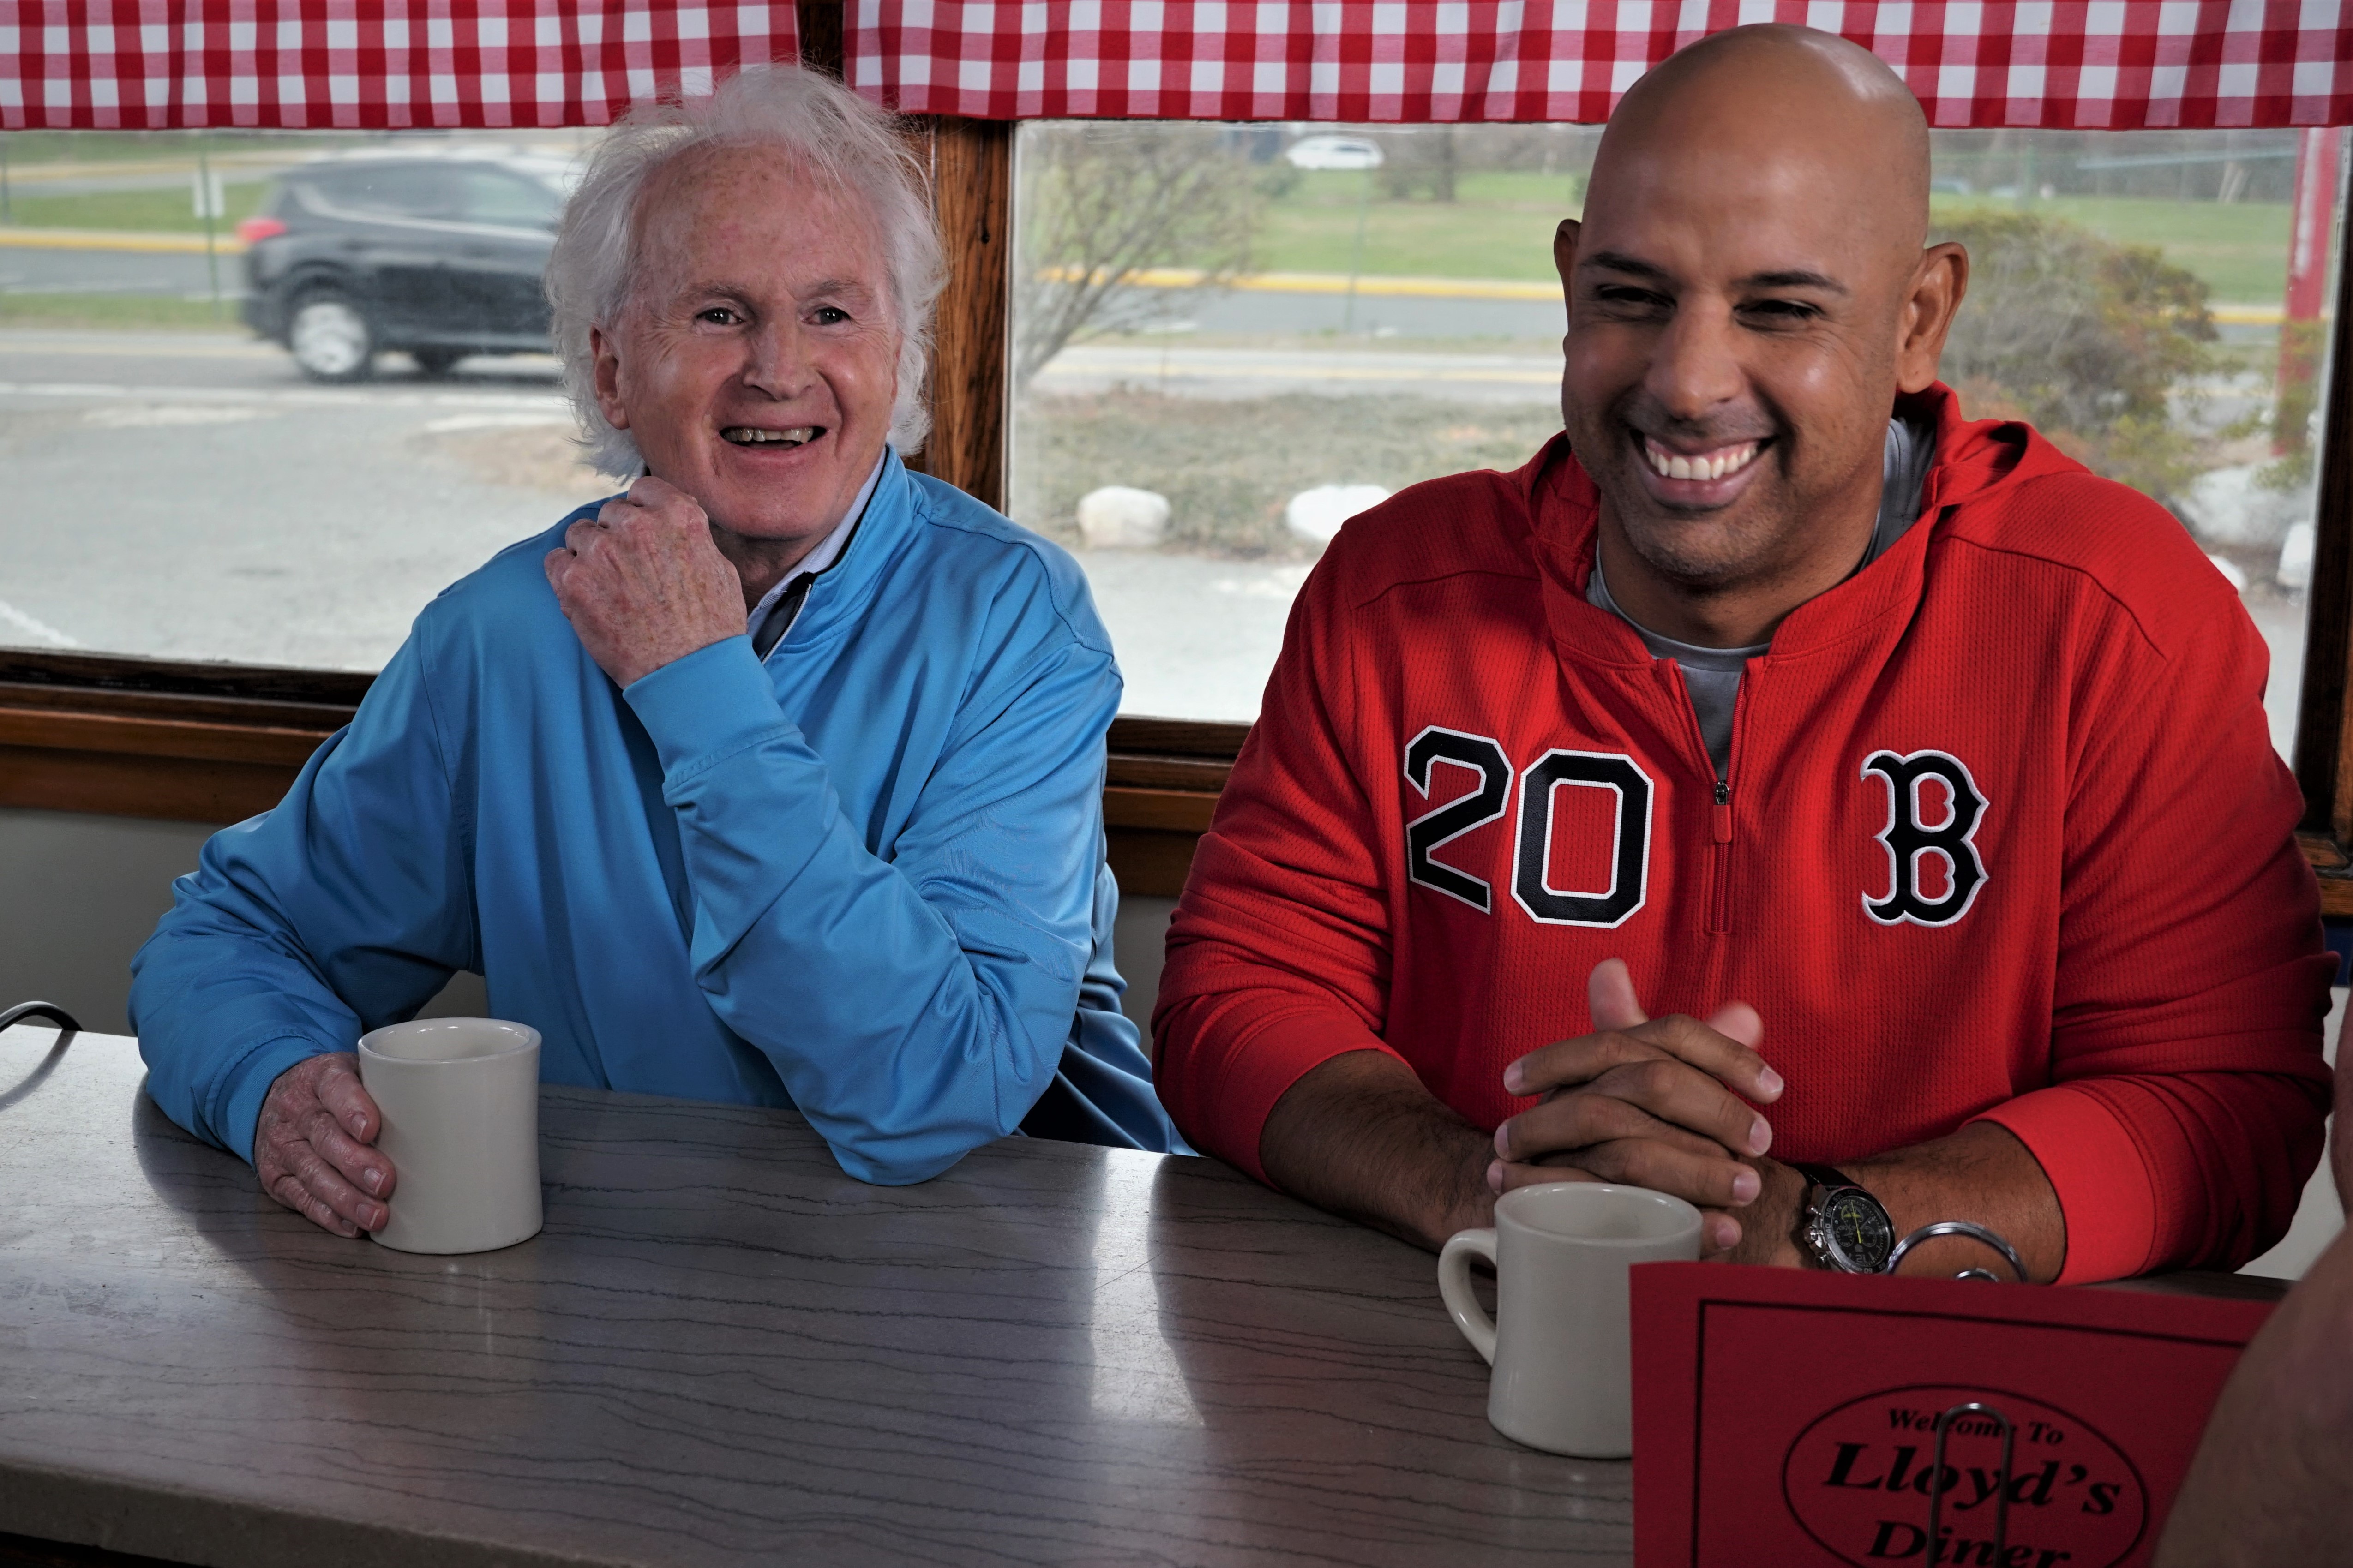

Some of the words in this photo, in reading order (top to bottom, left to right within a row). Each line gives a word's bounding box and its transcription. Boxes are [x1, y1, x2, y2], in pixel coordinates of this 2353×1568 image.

[1403, 725, 1654, 929] 20
[1860, 749, 1990, 926] B
[1855, 1254, 1867, 1263] 12
[1888, 1407, 2018, 1437] Welom
[2029, 1421, 2065, 1444] To
[1822, 1441, 2121, 1515] Lloyd's
[1866, 1520, 2071, 1568] Diner
